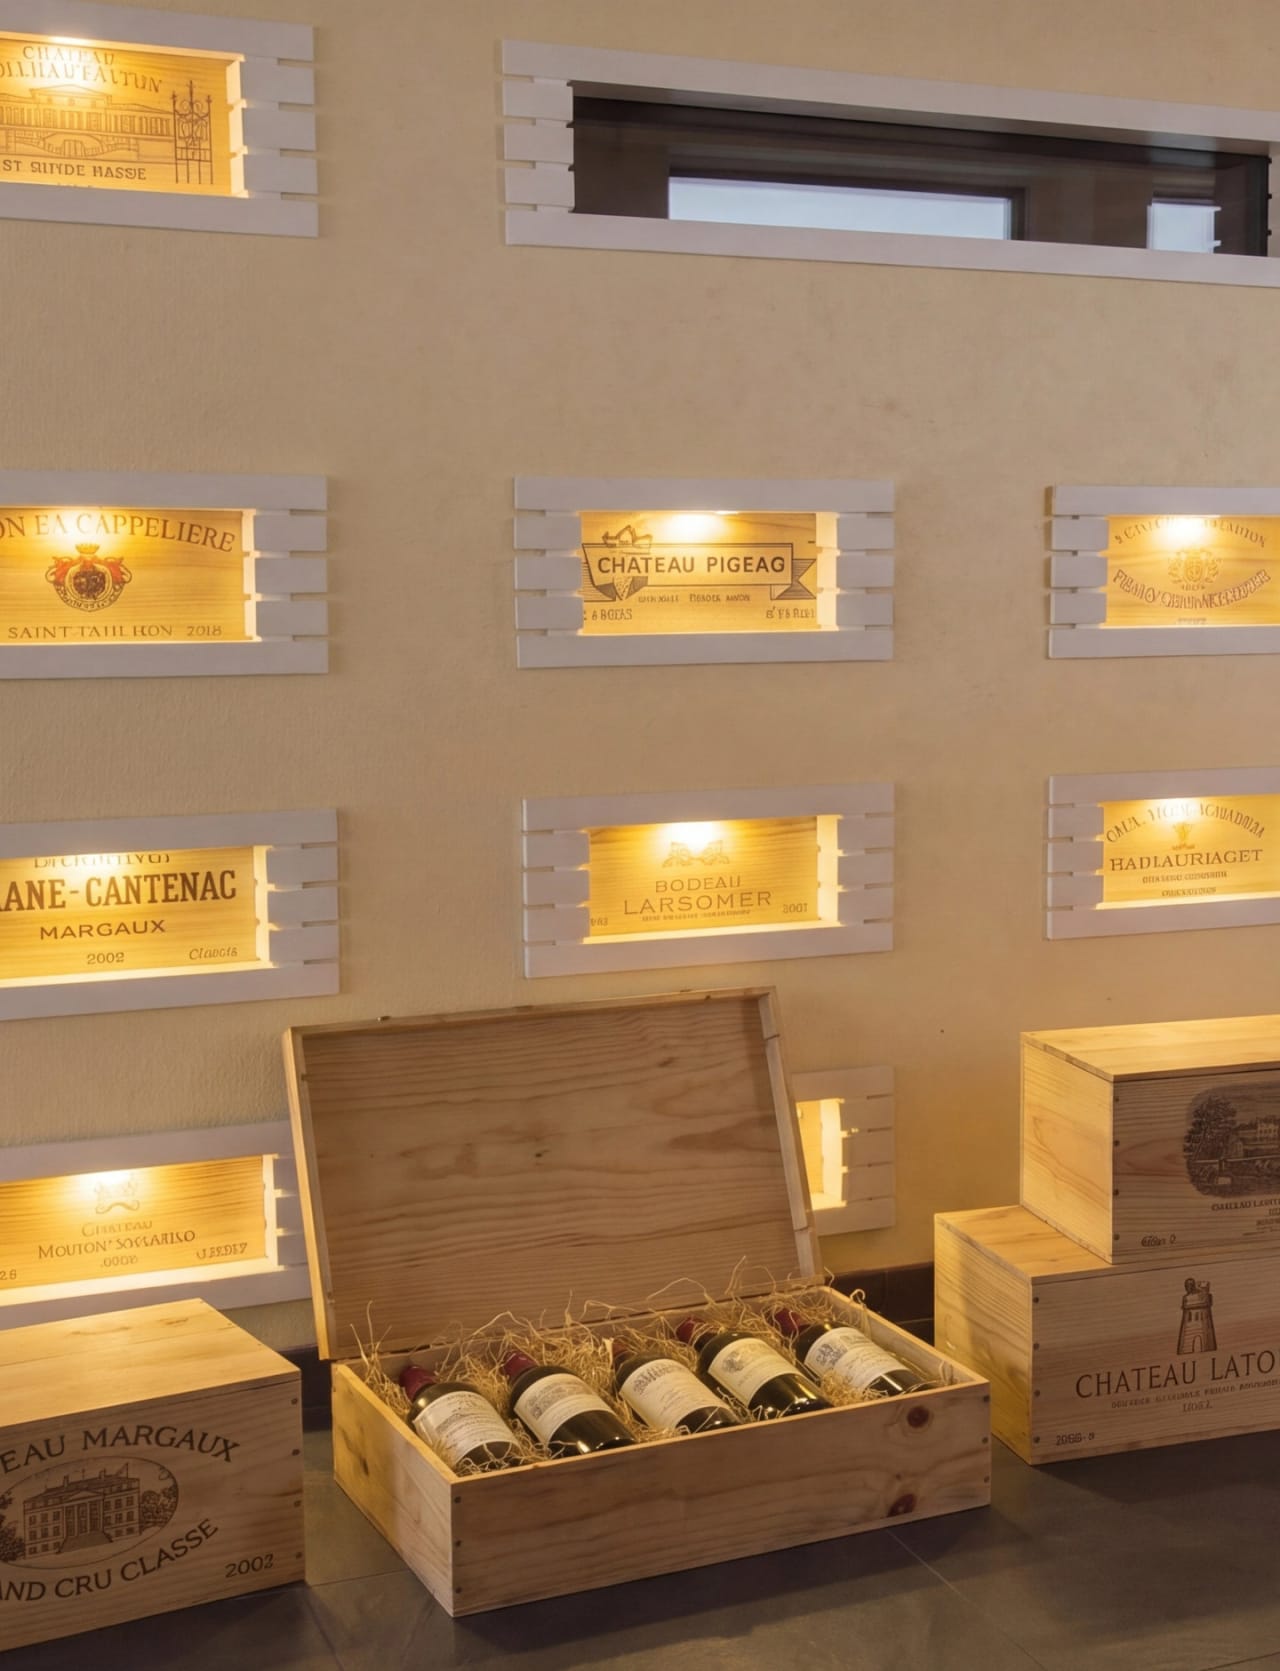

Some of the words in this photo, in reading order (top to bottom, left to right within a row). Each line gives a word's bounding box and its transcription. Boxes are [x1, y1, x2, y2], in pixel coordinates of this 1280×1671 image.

[597, 556, 696, 574] CHATEAU
[0, 869, 237, 912] ANE-CANTENAC
[623, 890, 773, 916] LARSOMER
[40, 919, 167, 941] MARGAUX
[1075, 1360, 1197, 1399] CHATEAU
[1211, 1350, 1276, 1381] LATO
[0, 1435, 66, 1474] EAU
[82, 1424, 241, 1463] MARGAUX
[0, 1580, 46, 1602] ND
[54, 1568, 112, 1598] CRU
[120, 1518, 219, 1582] CLASSE
